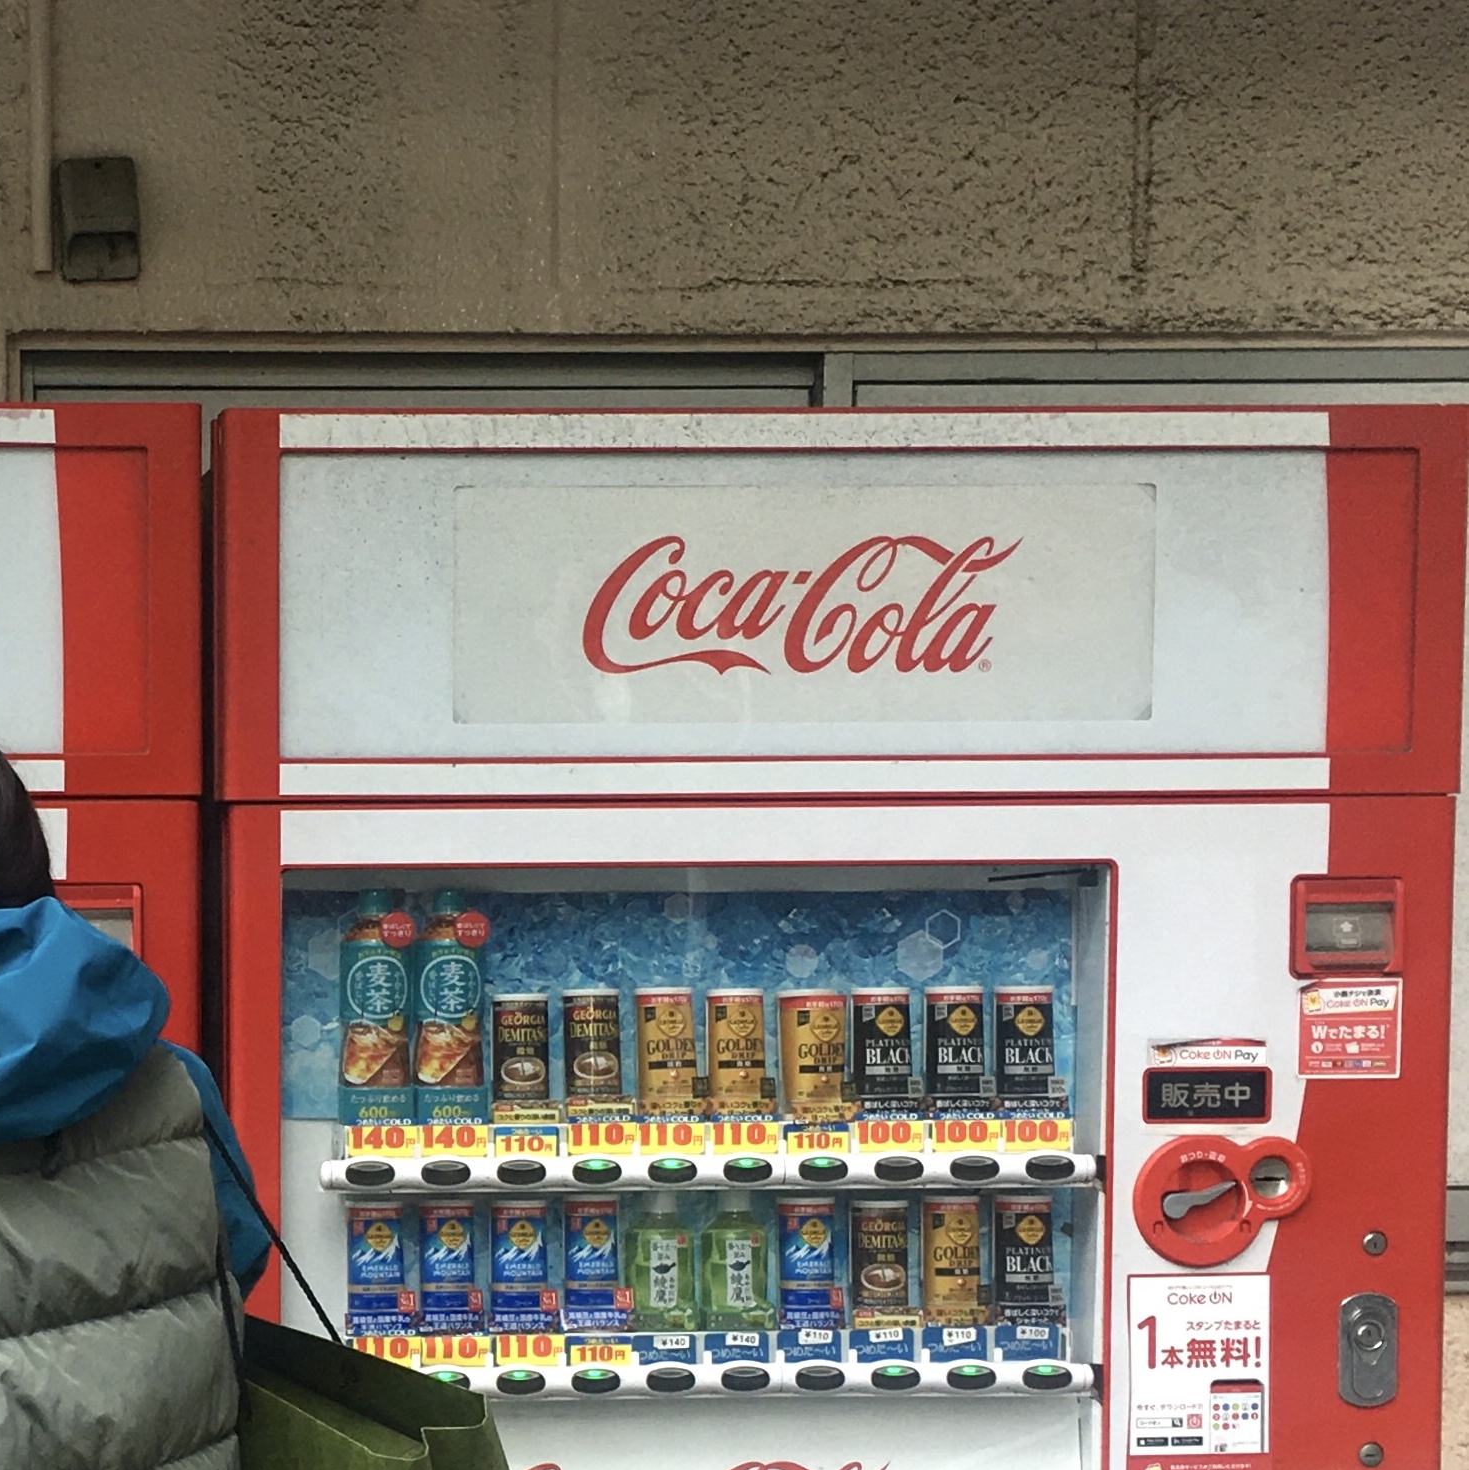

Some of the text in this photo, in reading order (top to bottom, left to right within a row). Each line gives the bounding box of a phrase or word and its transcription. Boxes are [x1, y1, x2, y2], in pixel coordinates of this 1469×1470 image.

[583, 536, 1024, 675] Coca-Cola
[457, 929, 484, 937] すっきり
[366, 962, 393, 1012] 麦茶
[440, 962, 466, 1012] 麦茶
[1370, 998, 1389, 1007] Pay
[1311, 1024, 1385, 1039] Wでたまる!
[1180, 1049, 1258, 1062] Coke ON Pay
[351, 1095, 407, 1103] たっぷり飲める
[1161, 1082, 1251, 1108] 販売中
[351, 1126, 415, 1149] 140円
[423, 1126, 486, 1148] 140円
[571, 1123, 634, 1146] 110円
[639, 1123, 703, 1146] 110円
[713, 1123, 776, 1145] 110円
[858, 1121, 921, 1144] 100円
[935, 1121, 998, 1143] 100円
[1005, 1120, 1069, 1143] 100円
[501, 1137, 552, 1152] 110円
[794, 1133, 842, 1149] 110円
[654, 1276, 667, 1304] 綾鷹
[731, 1273, 745, 1302] 綾鷹
[1167, 1291, 1233, 1305] Coke ON
[1021, 1328, 1046, 1337] ¥100
[1186, 1320, 1261, 1330] スタンプたまると
[662, 1338, 686, 1346] ¥140
[732, 1335, 756, 1344] ¥140
[805, 1331, 829, 1340] ¥110
[875, 1330, 899, 1340] ¥110
[947, 1330, 971, 1340] ¥110
[1137, 1315, 1261, 1369] 1本無料!
[577, 1346, 625, 1362] 110円
